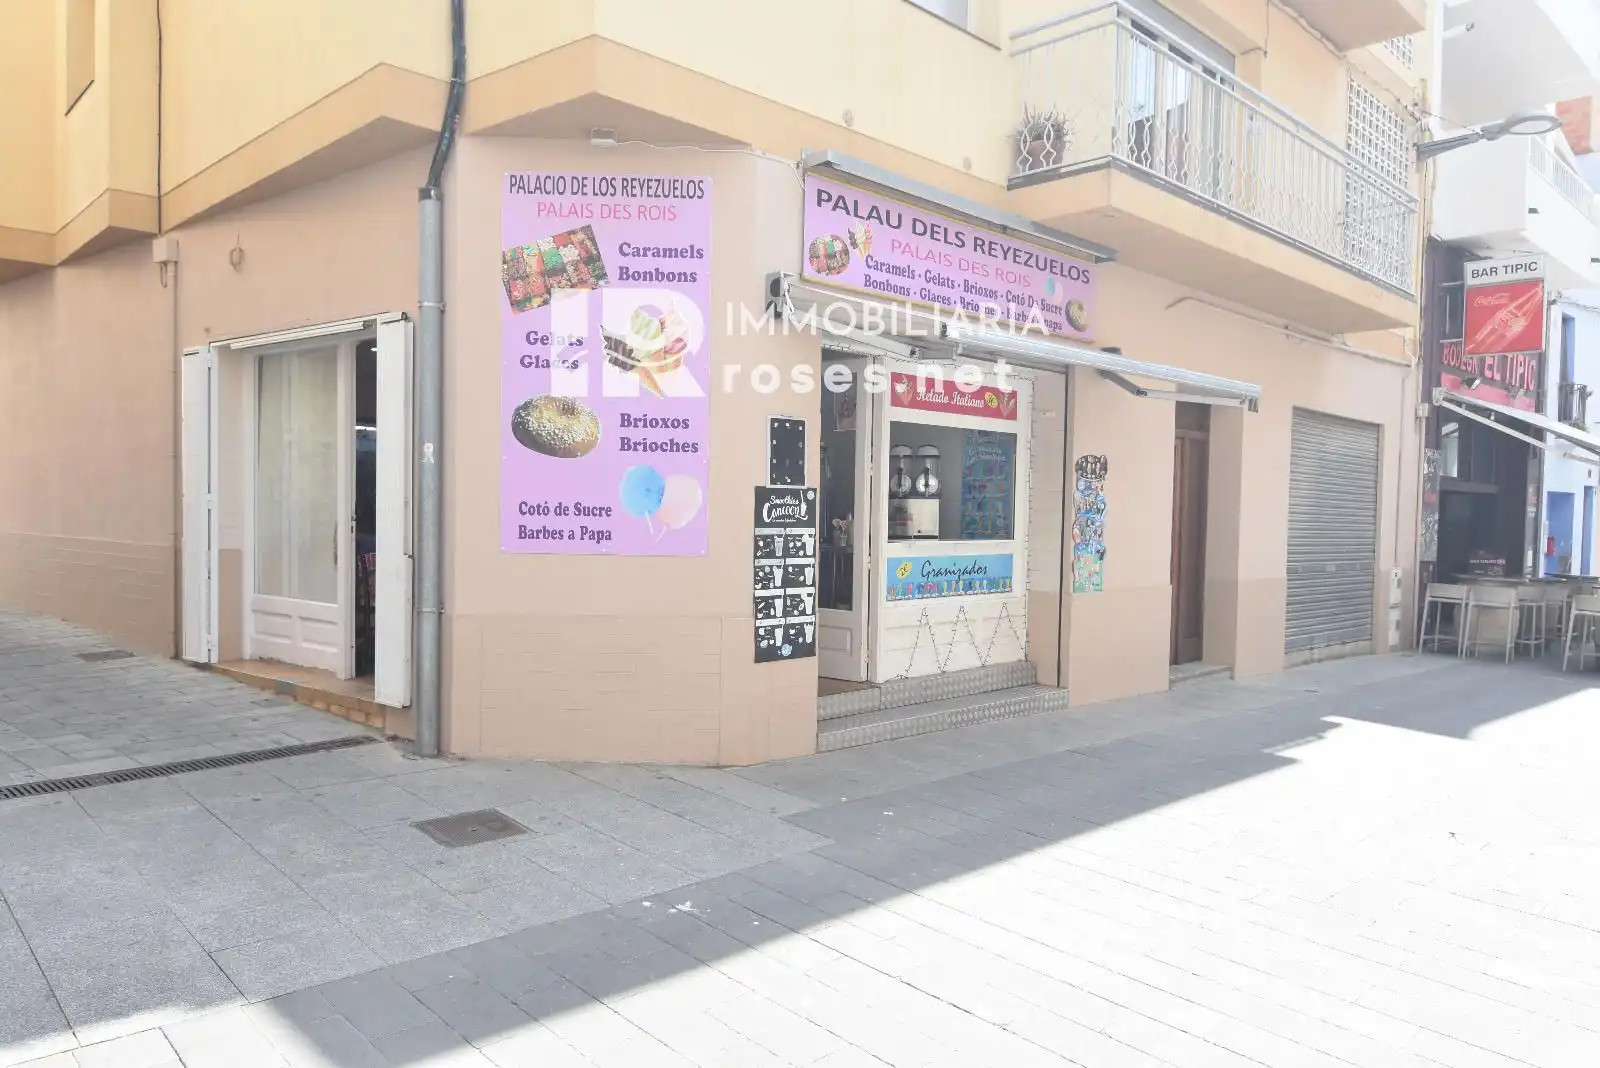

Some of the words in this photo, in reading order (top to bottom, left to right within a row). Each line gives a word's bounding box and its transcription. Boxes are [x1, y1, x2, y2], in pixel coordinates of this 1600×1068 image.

[509, 174, 567, 196] PALACIO
[571, 176, 588, 196] DE
[592, 176, 617, 198] LOS
[621, 177, 705, 199] REYEZUELOS
[537, 202, 594, 219] PALAIS
[600, 203, 632, 220] DES
[638, 204, 677, 221] ROIS
[815, 188, 902, 230] PALAU
[911, 217, 966, 249] DELS
[973, 236, 1091, 285] REYEZUELOS
[618, 242, 704, 259] Caramels
[891, 239, 953, 267] PALAIS
[958, 257, 990, 276] DES
[995, 267, 1032, 288] ROIS
[1472, 267, 1498, 279] BAR
[1502, 262, 1538, 275] TIPIC
[618, 266, 698, 283] Bonbons
[864, 273, 911, 297] Bonbons
[920, 287, 951, 306] Glaces
[865, 254, 916, 280] Caramels
[925, 269, 956, 290] Gelats
[963, 279, 998, 300] Brioxos
[1041, 298, 1063, 316] Sucre
[525, 330, 584, 347] Gelats
[519, 354, 580, 370] Glaces
[1485, 355, 1501, 381] EL
[1503, 352, 1536, 393] TIPIC
[951, 391, 985, 408] Italiano
[619, 412, 690, 429] Brioxos
[619, 436, 699, 453] Brioches
[518, 501, 550, 517] Cotó
[554, 501, 570, 517] de
[573, 502, 613, 517] Sucre
[518, 525, 564, 540] Barbes
[567, 529, 575, 541] a
[579, 526, 612, 544] Papa
[921, 560, 988, 584] Granizados
